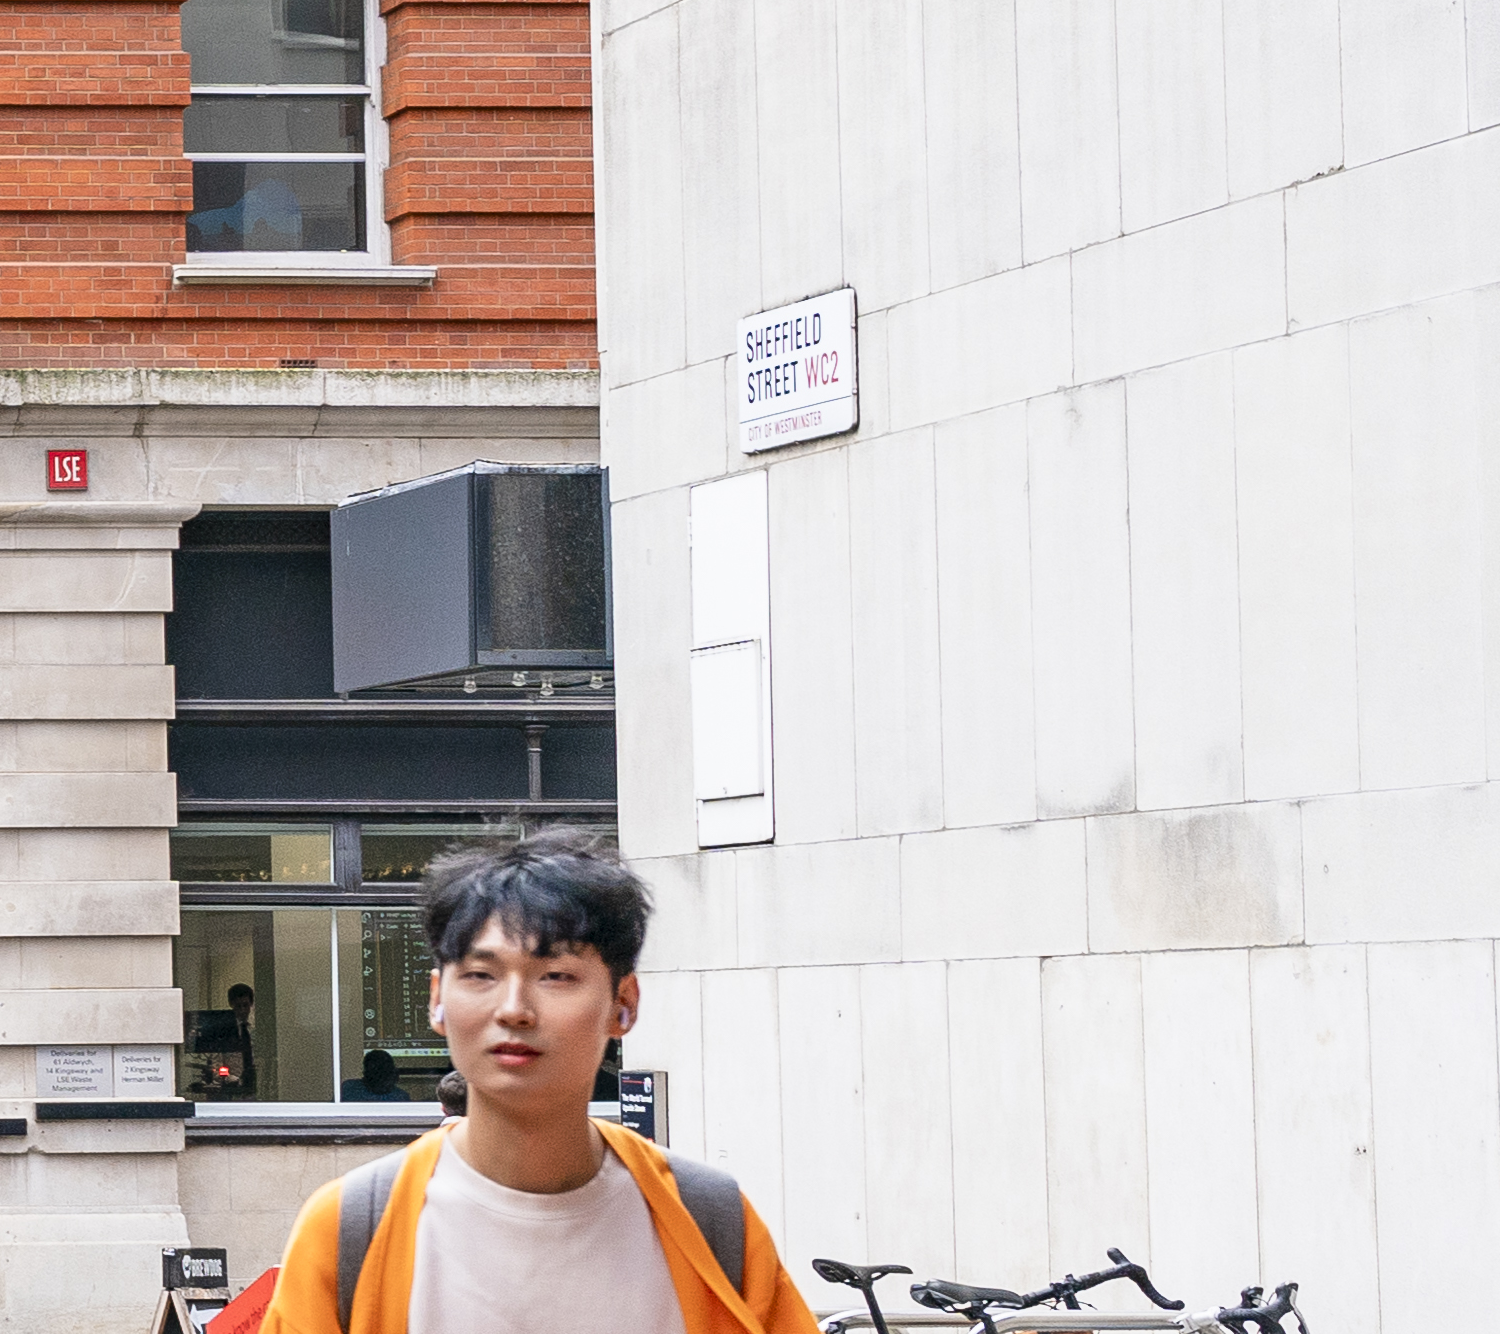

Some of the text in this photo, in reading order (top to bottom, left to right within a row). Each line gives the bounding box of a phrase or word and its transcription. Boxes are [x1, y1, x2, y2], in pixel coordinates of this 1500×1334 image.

[746, 312, 822, 363] SHEFFIELD
[747, 350, 839, 404] STREET WC2
[748, 411, 823, 442] CITY OF WESTMINSTER
[54, 456, 81, 482] LSE
[50, 1049, 97, 1057] Deliveries for
[121, 1055, 161, 1064] Deliveries for
[55, 1067, 88, 1076] Kingsway
[90, 1067, 103, 1075] and
[130, 1066, 160, 1074] Kingsway
[52, 1085, 98, 1093] Management
